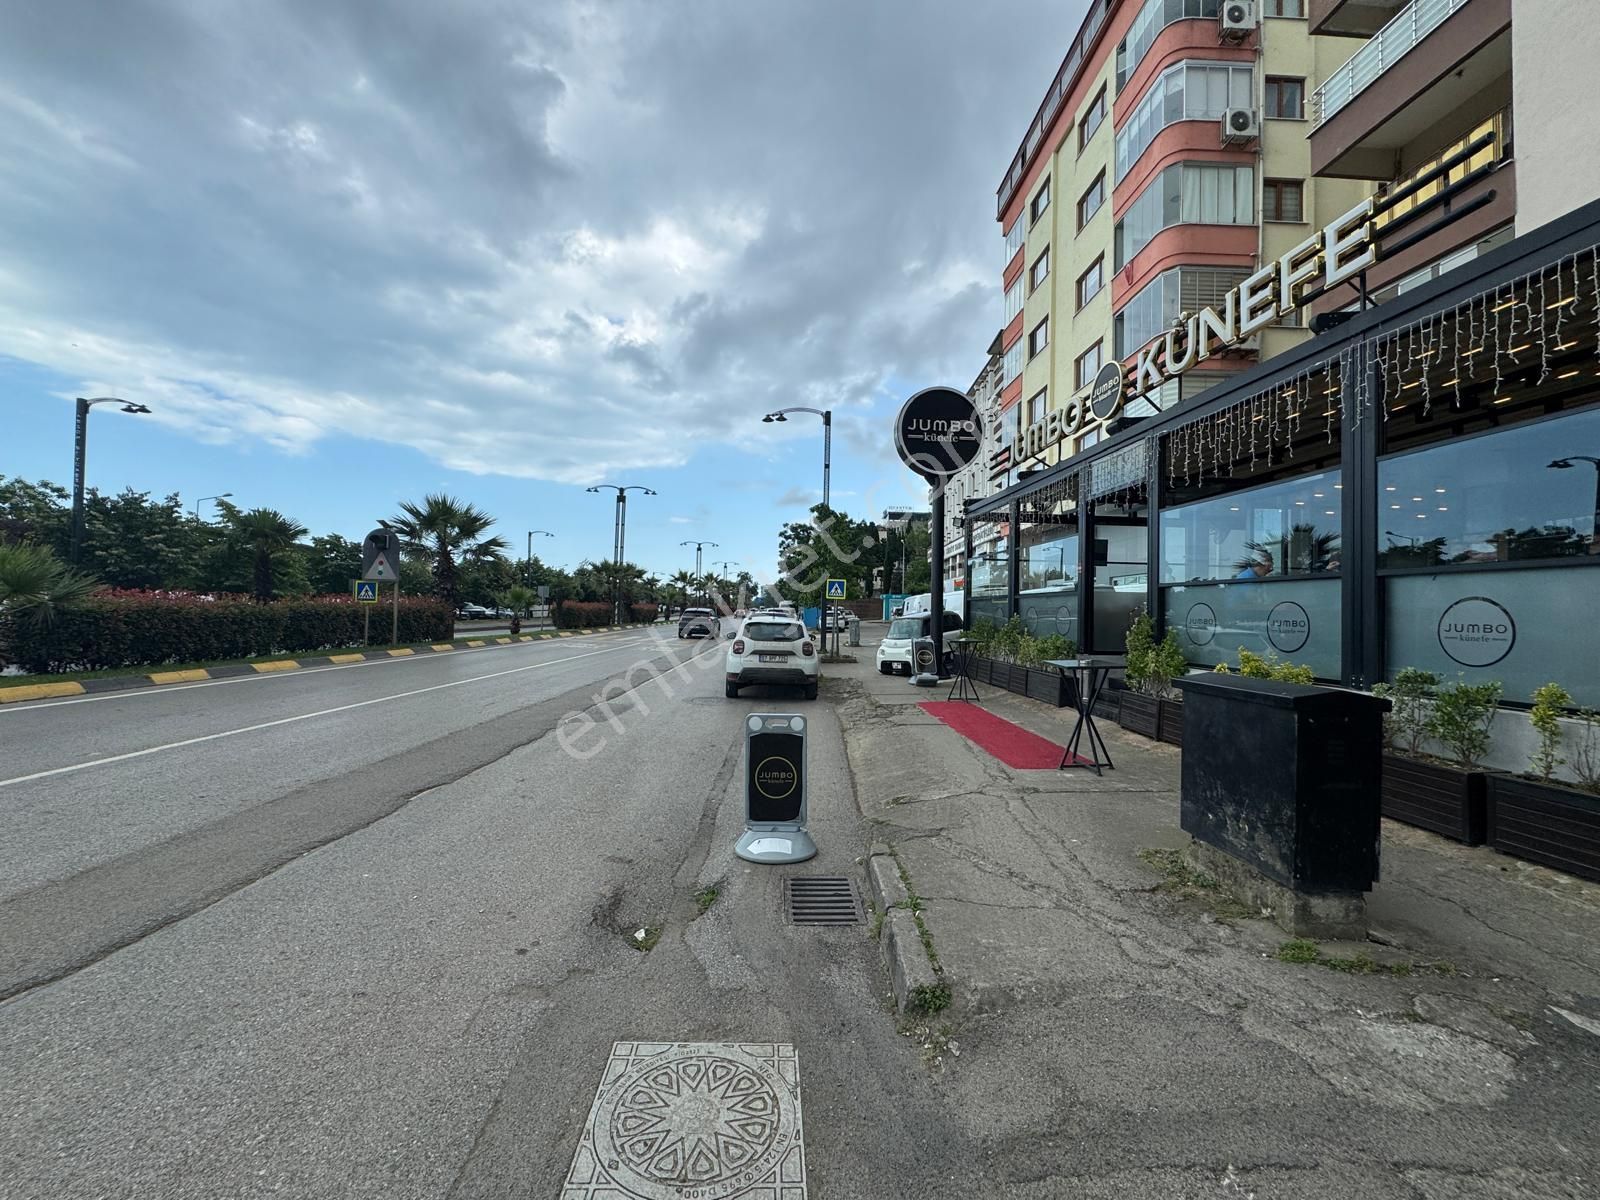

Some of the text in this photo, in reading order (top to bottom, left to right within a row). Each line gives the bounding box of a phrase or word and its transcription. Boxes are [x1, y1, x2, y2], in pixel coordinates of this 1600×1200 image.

[1136, 194, 1380, 396] KÜNEFE
[1092, 376, 1119, 398] JUMBO
[907, 418, 975, 432] JUMBO
[923, 432, 959, 443] künefe
[1005, 396, 1083, 469] JUMBO
[1188, 617, 1214, 626] JUMBO
[1271, 619, 1306, 628] JUMBO
[1443, 623, 1508, 634] JUMBO
[1459, 634, 1490, 643] künefe
[759, 771, 793, 779] JUMBO
[683, 1187, 718, 1200] D400
